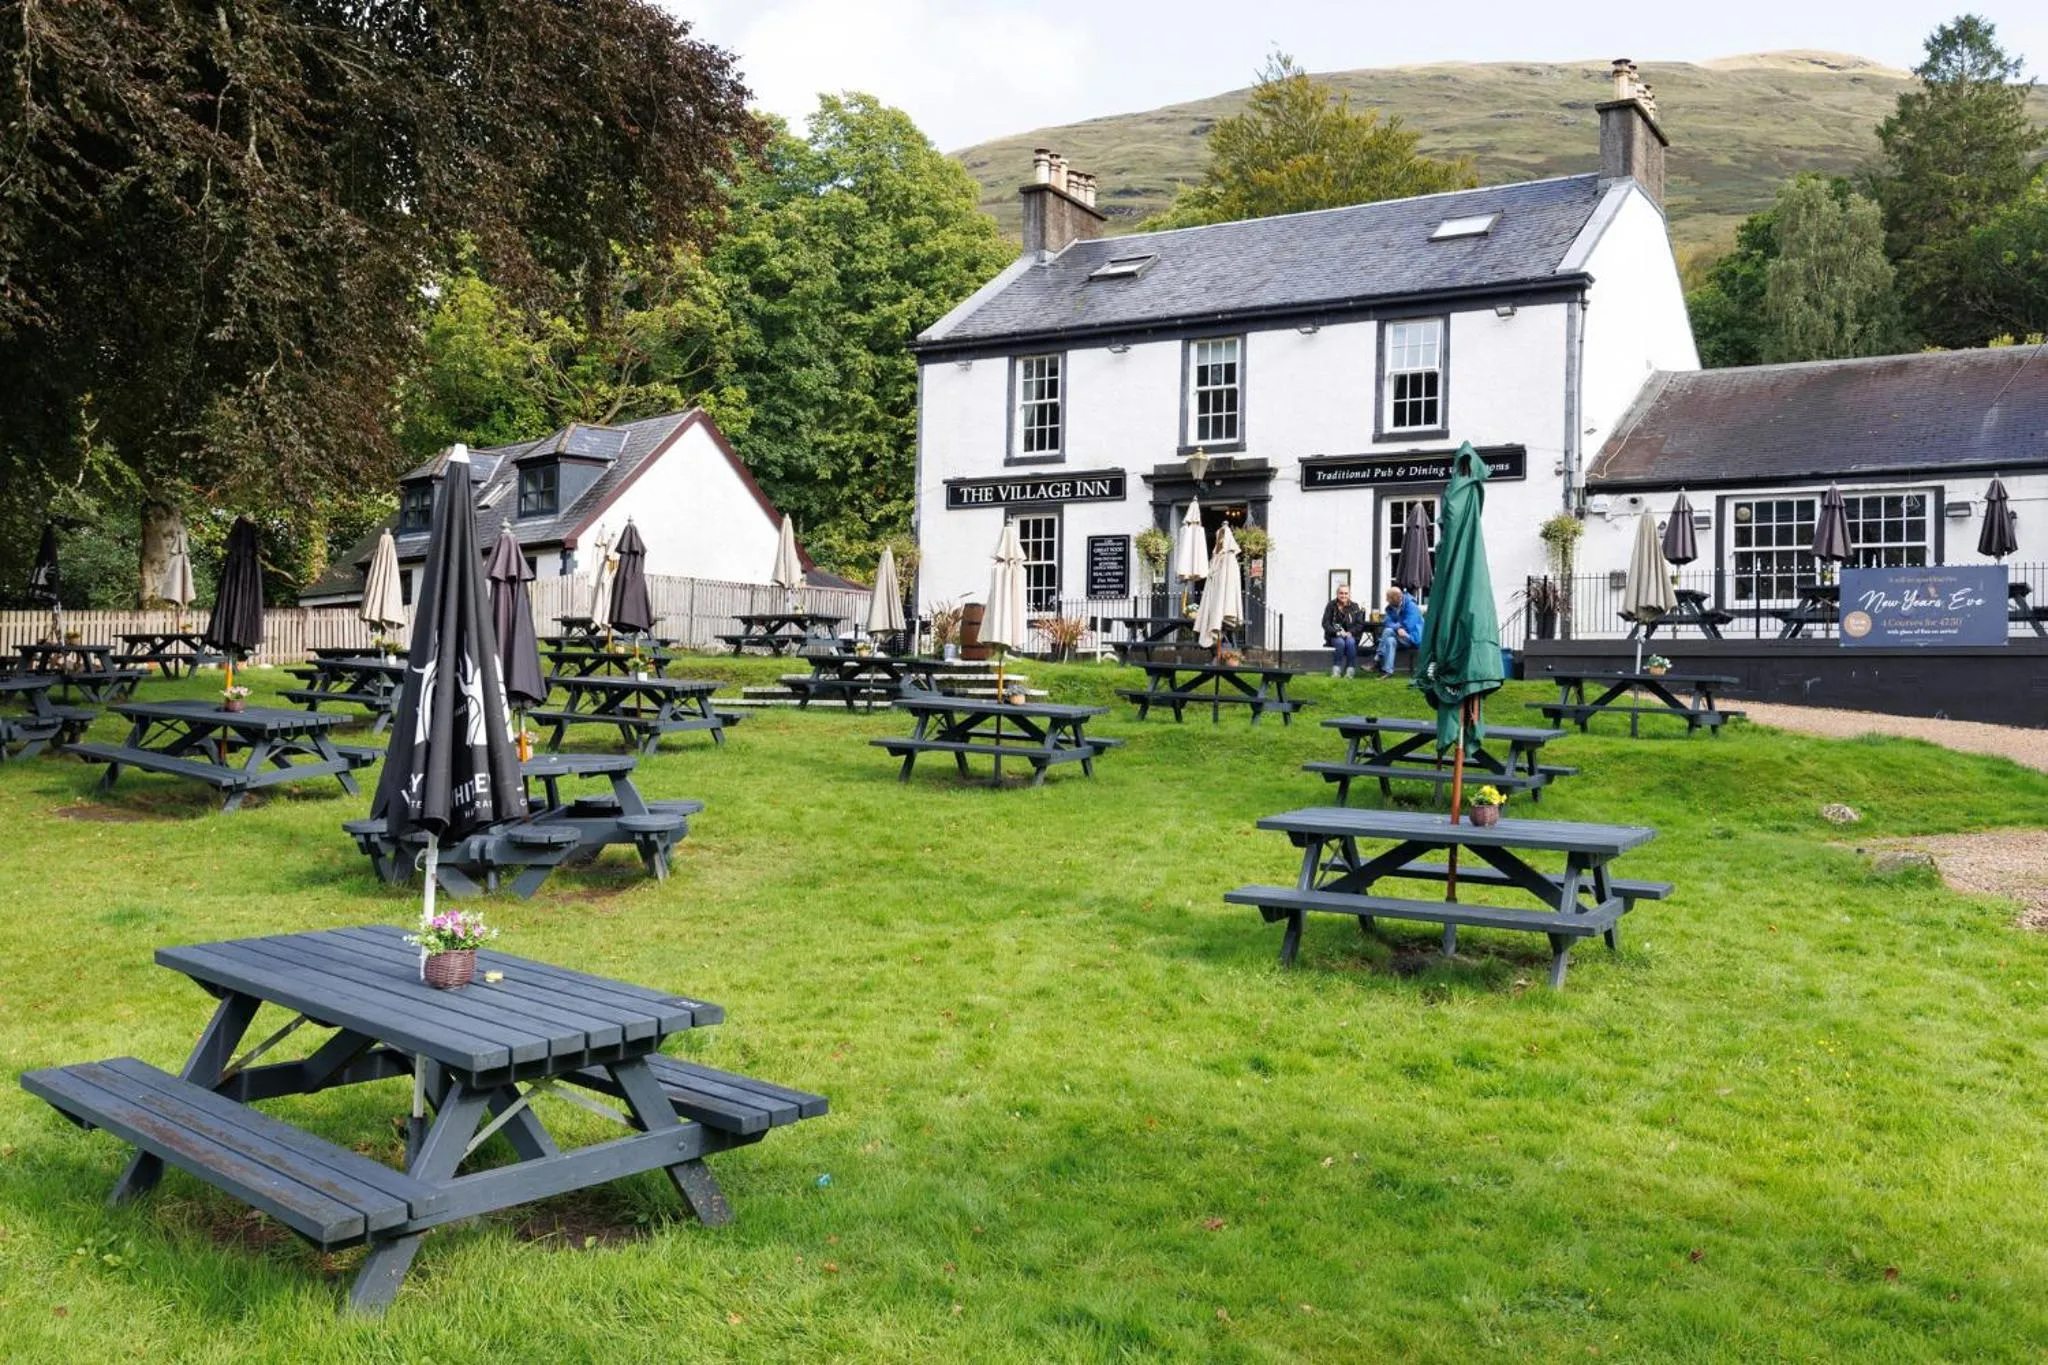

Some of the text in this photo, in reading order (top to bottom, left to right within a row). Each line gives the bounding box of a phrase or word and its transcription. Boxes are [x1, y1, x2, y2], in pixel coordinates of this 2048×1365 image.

[1316, 468, 1371, 480] Traditional
[1374, 467, 1394, 478] Pub
[1396, 467, 1406, 477] &
[1409, 465, 1446, 477] Dining
[959, 480, 1111, 503] THE VILLAGE INN
[1858, 590, 1901, 613] New
[1948, 587, 1985, 610] Eve
